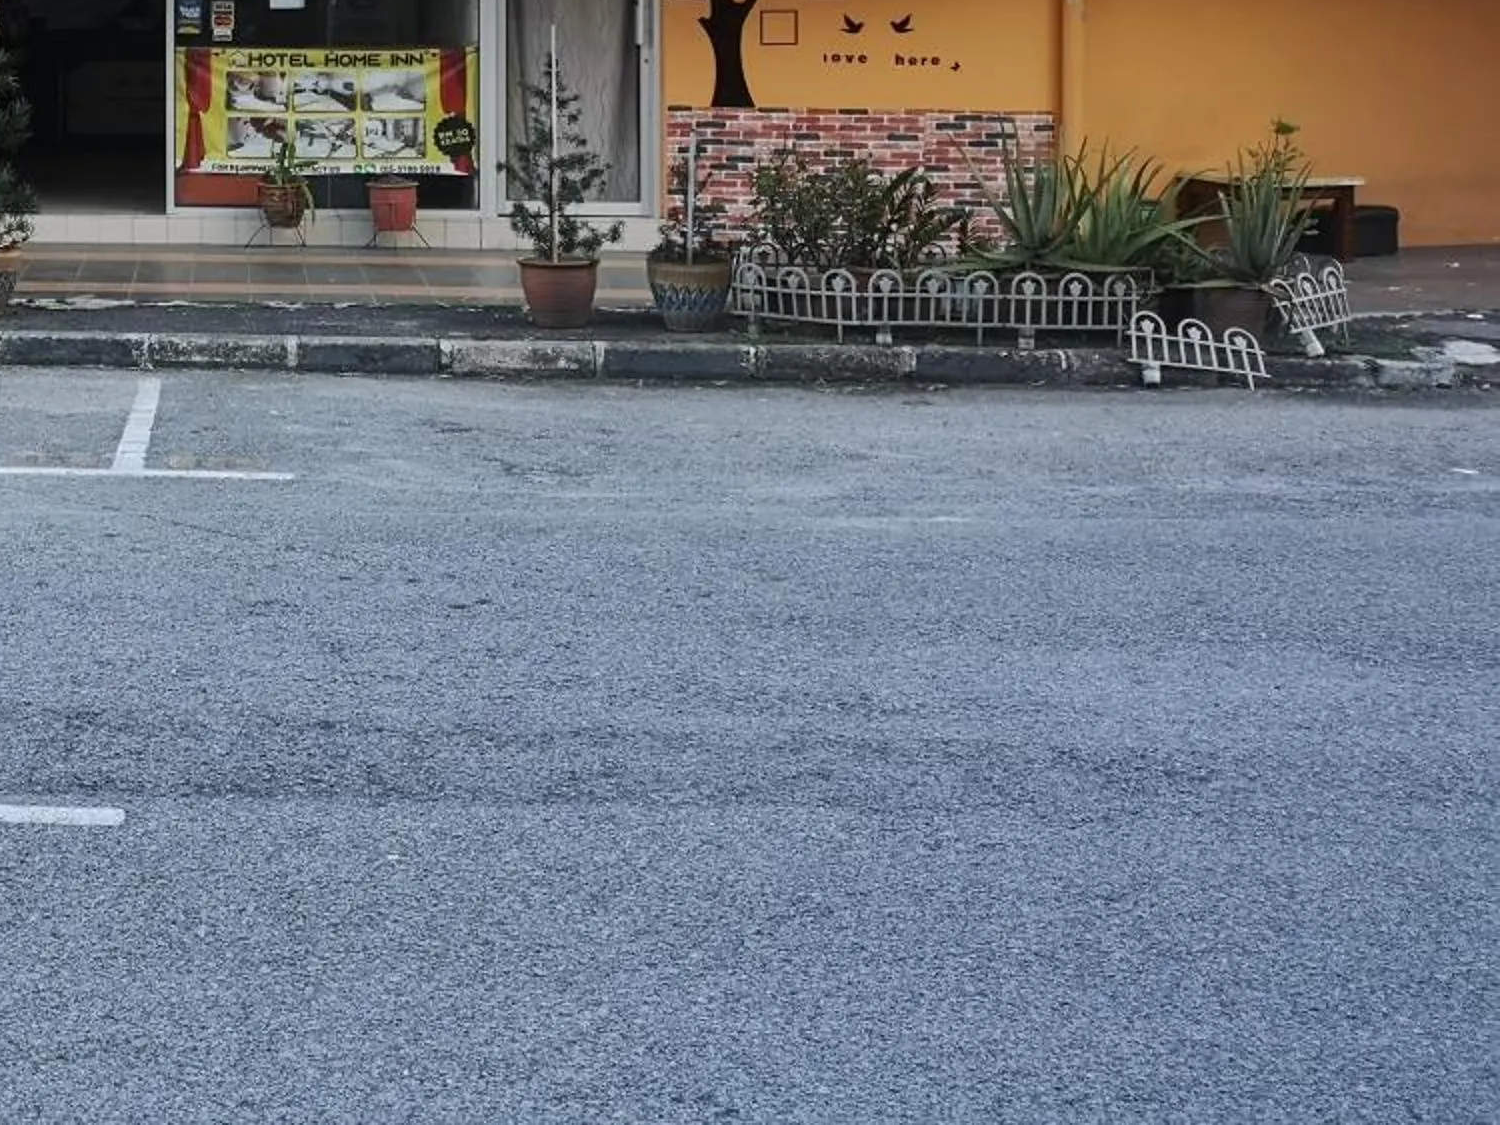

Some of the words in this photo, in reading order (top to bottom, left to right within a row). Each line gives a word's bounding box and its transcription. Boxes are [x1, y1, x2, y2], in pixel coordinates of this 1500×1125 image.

[248, 53, 315, 68] HOTEL
[324, 53, 382, 68] HOME
[390, 53, 424, 67] INN
[895, 53, 941, 66] here
